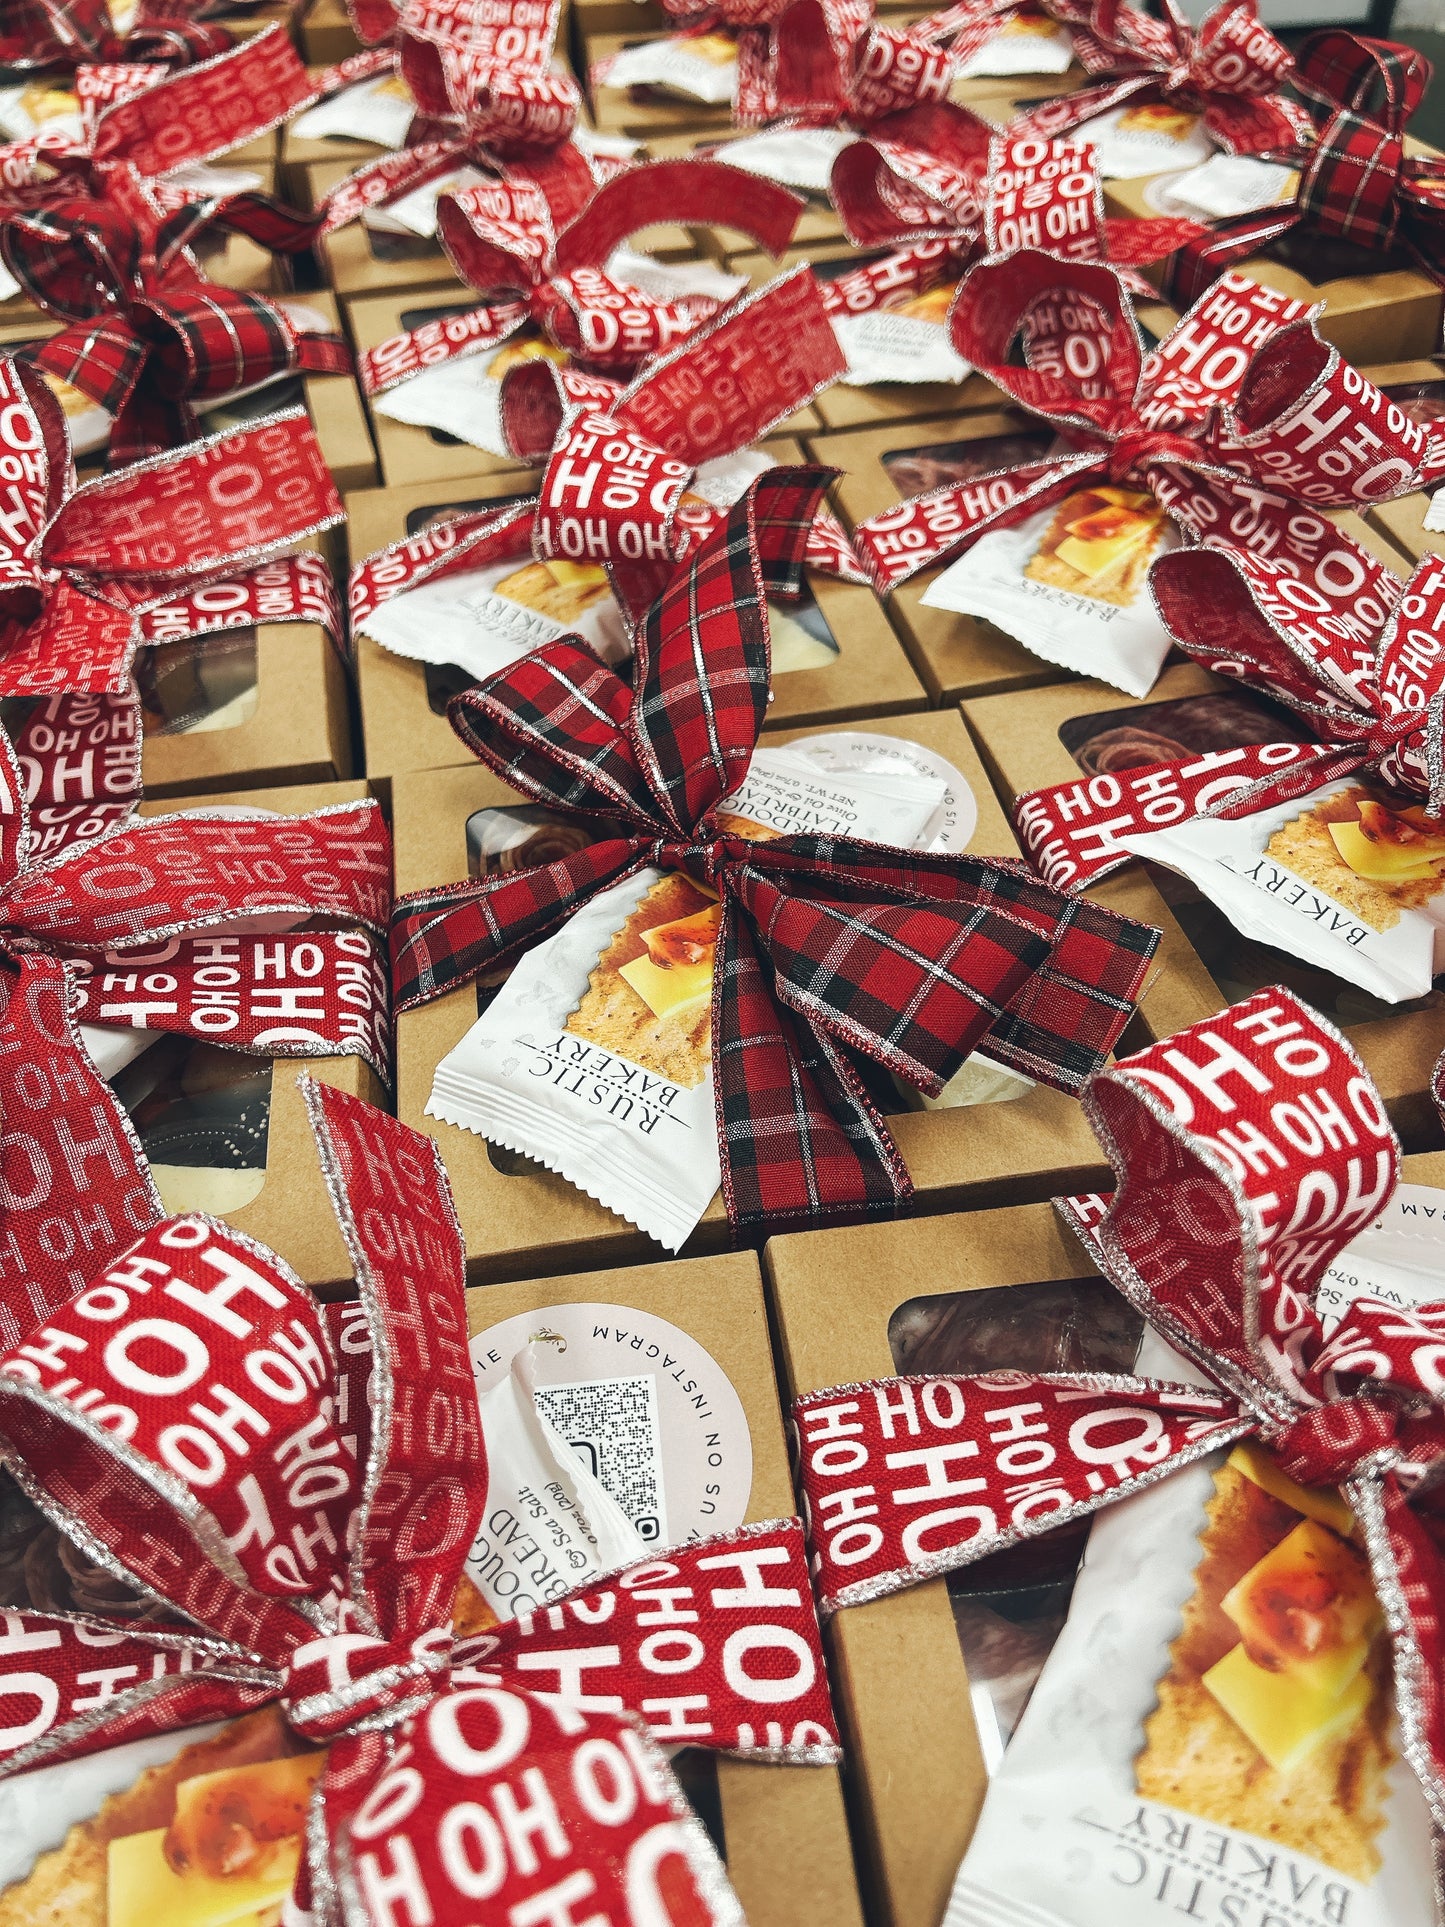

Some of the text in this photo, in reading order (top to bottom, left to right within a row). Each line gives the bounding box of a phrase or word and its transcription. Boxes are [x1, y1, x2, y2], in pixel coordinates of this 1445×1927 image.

[1202, 293, 1250, 335] HO
[963, 480, 1017, 520] HO
[873, 530, 928, 556] HO
[1399, 629, 1440, 681] HO
[1054, 774, 1124, 822] HO
[1245, 859, 1370, 948] BAKERY
[103, 973, 178, 993] HO
[254, 942, 325, 980] HO
[529, 1056, 661, 1135] RUSTIC
[546, 1036, 681, 1108] BAKERY
[592, 1325, 723, 1515] US ON INSTAGRAM
[873, 1380, 966, 1440] HO
[517, 1486, 550, 1520] Salt
[541, 1518, 572, 1549] Sea
[699, 1546, 817, 1704] HO
[1110, 1843, 1291, 1927] STIC
[1122, 1806, 1351, 1926] BAKERY
